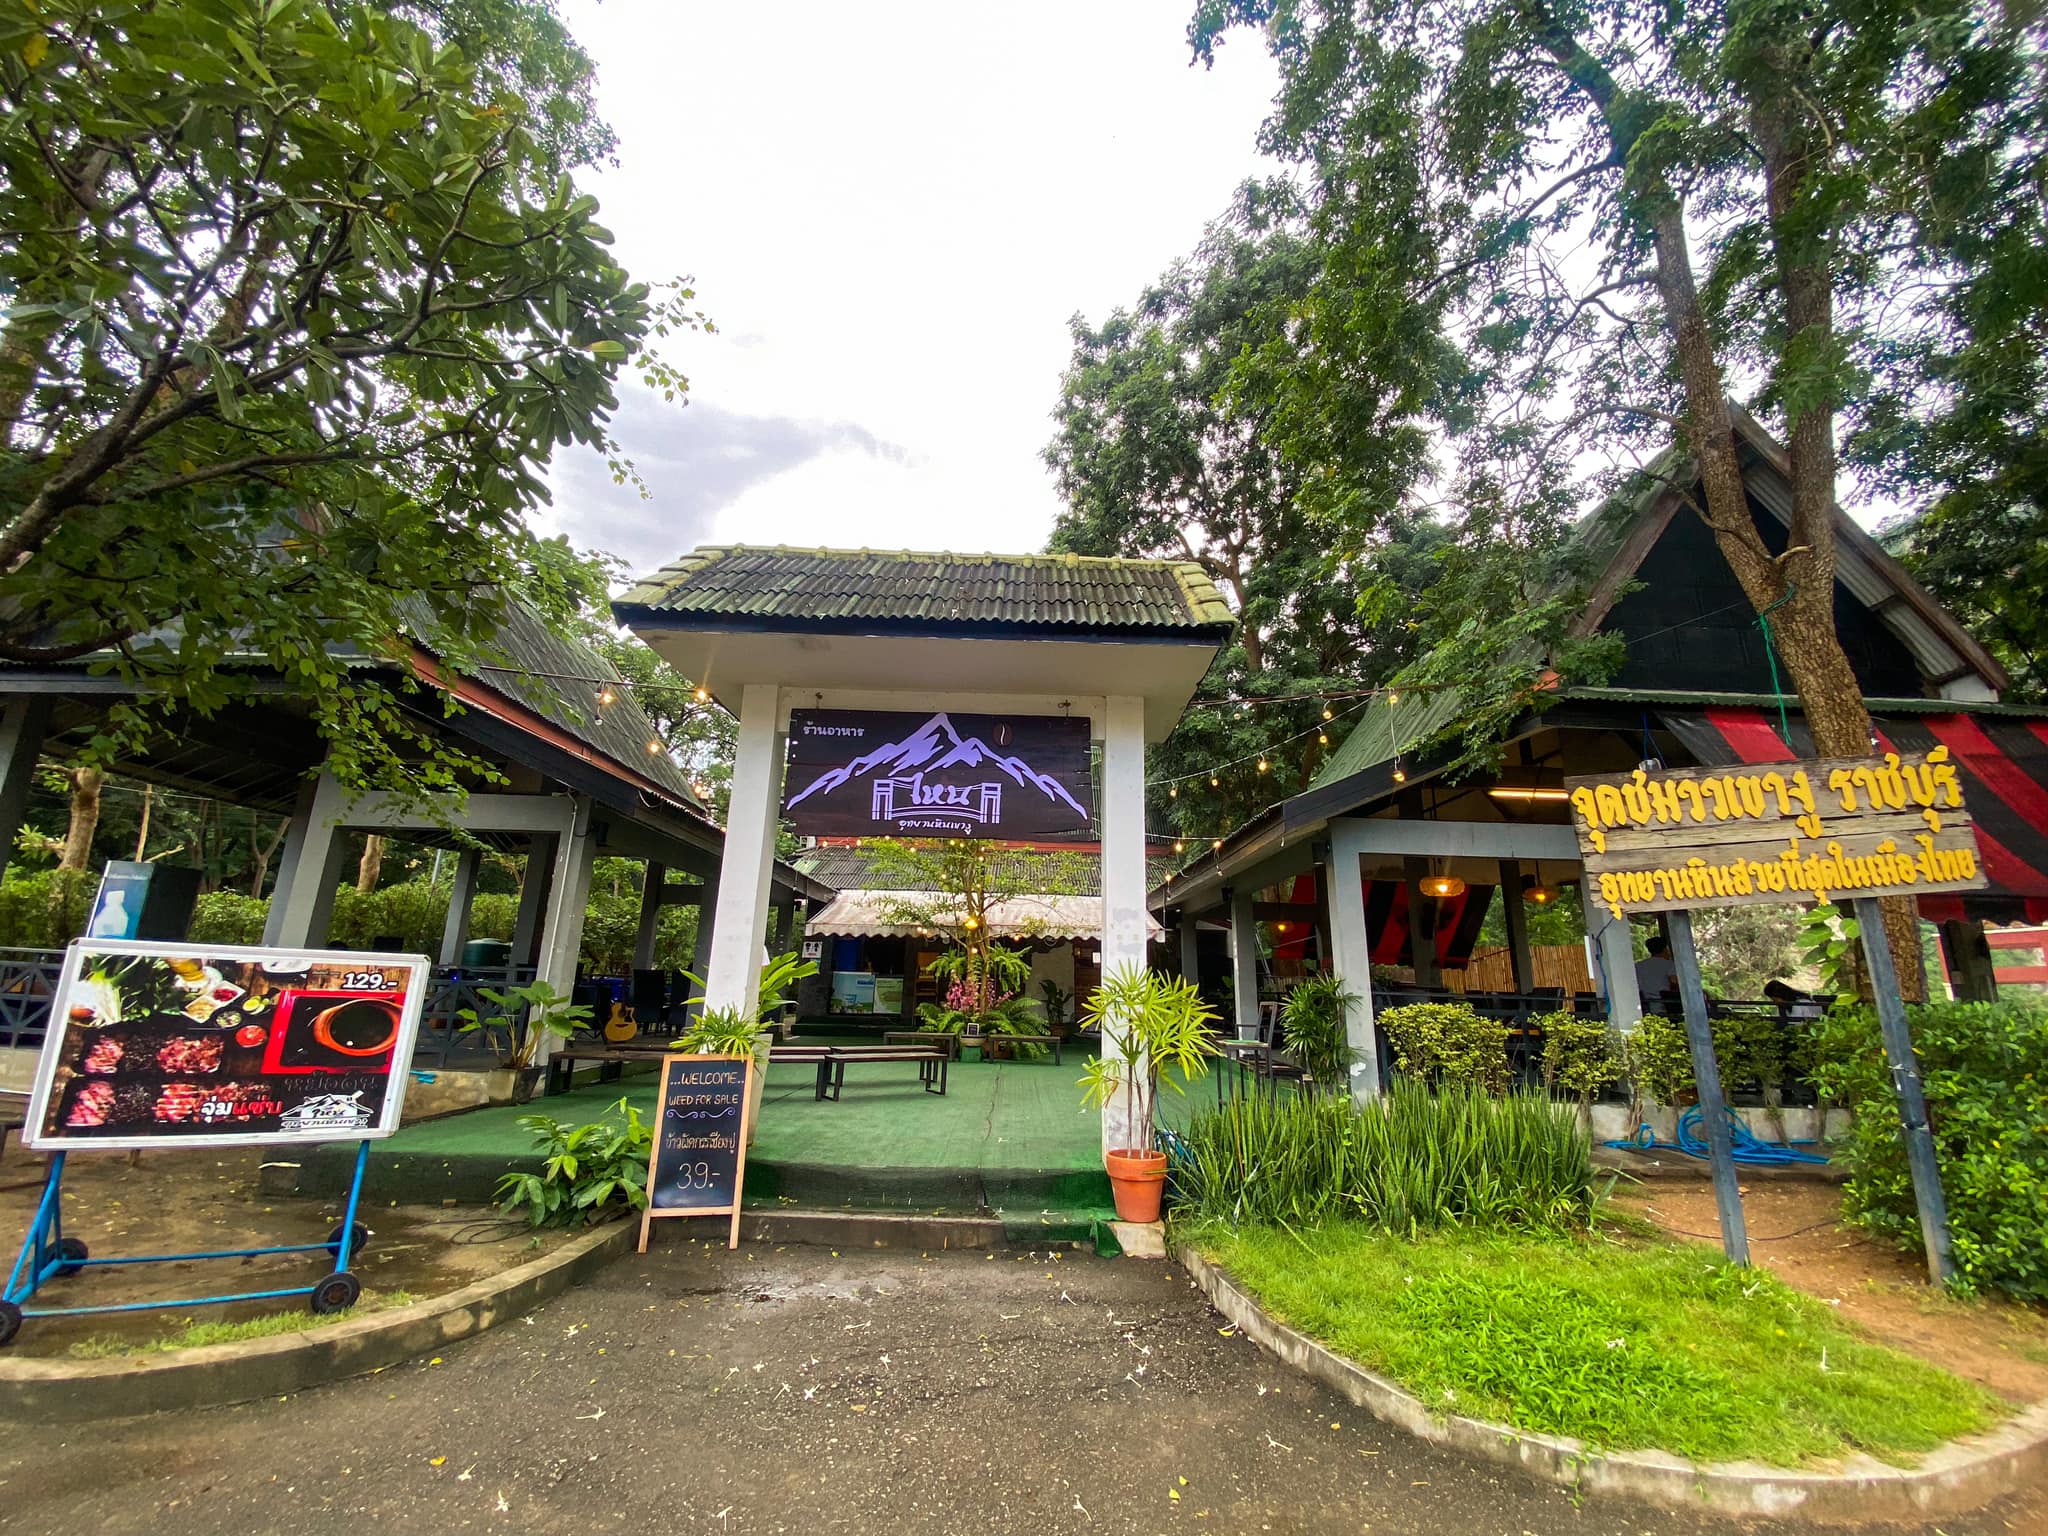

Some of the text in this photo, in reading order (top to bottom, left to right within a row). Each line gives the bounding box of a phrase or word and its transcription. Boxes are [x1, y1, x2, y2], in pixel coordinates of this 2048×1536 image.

[803, 720, 865, 737] ร้านอาหาร
[1829, 745, 1962, 833] ราชบุรี
[899, 818, 972, 836] อุทยานหินเขางู
[1599, 833, 1977, 920] อุทยานหินสวยที่สุดในเมืองไทย
[342, 971, 399, 990] 129.-
[201, 1095, 283, 1123] จุ่มแซ่บ
[669, 1094, 739, 1106] WEED FOR SALE
[677, 1162, 720, 1189] 39.-
